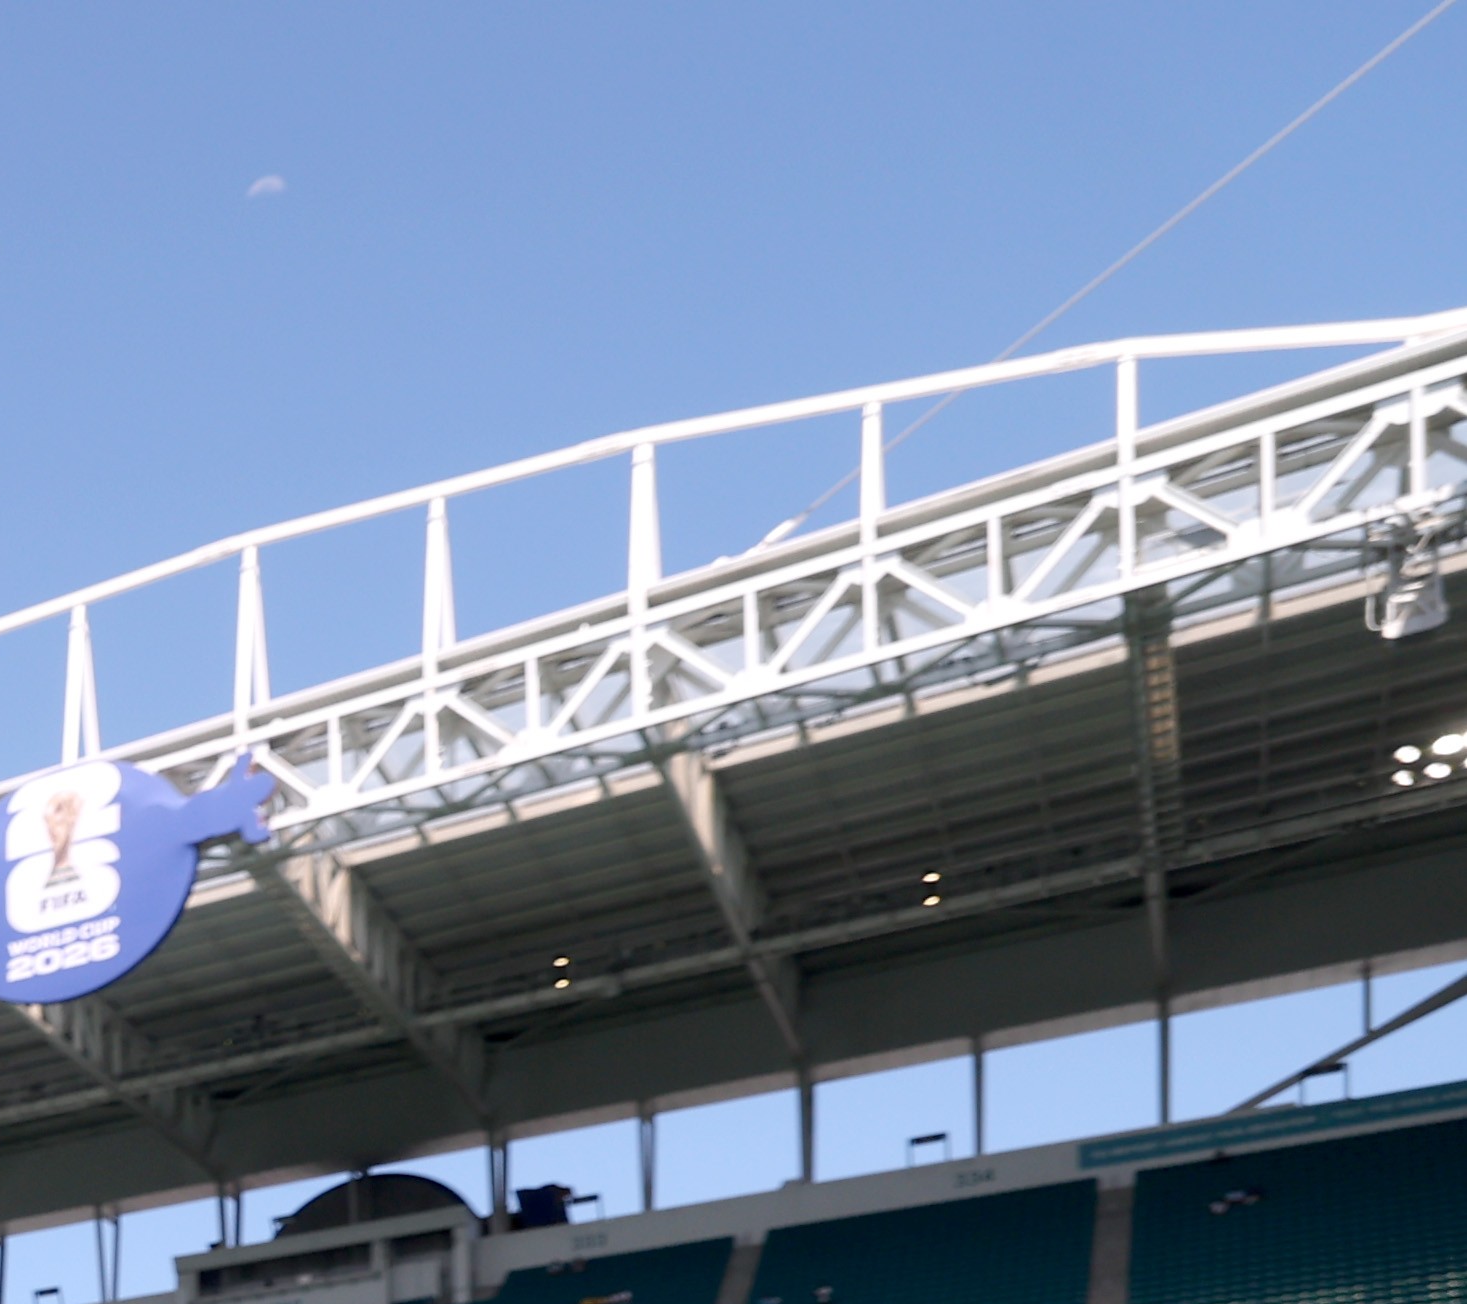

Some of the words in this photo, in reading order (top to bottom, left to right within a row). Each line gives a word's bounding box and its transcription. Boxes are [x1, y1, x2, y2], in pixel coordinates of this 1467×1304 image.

[40, 890, 87, 914] FIFA
[7, 926, 79, 957] WORLD
[79, 915, 121, 940] CUP
[5, 934, 121, 983] 2026
